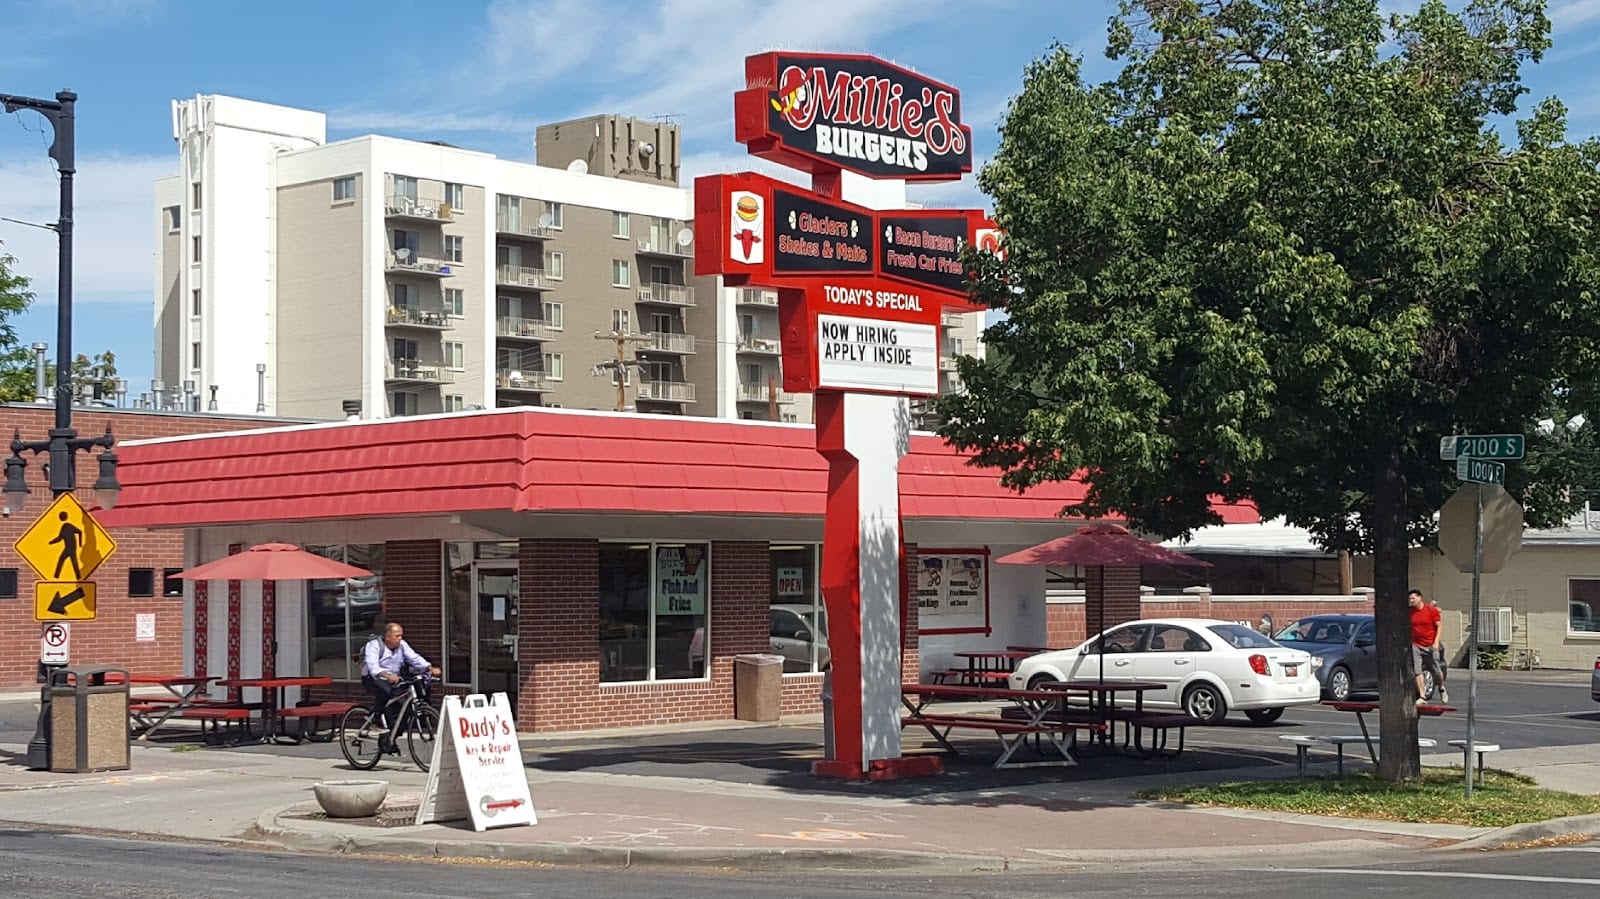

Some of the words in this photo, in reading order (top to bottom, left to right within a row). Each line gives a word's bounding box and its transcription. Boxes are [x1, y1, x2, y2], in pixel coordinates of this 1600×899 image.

[815, 124, 929, 172] BURGERS
[799, 212, 848, 237] Glaciers
[779, 234, 820, 257] Shakes
[822, 240, 834, 259] &
[836, 242, 867, 263] Malts
[895, 226, 921, 247] Bacon
[922, 230, 955, 252] Burgers
[887, 249, 917, 268] Fresh
[918, 253, 937, 271] Cut
[937, 257, 963, 275] Fries
[824, 285, 874, 307] TODAY'S
[875, 291, 923, 312] SPECIAL
[822, 321, 849, 341] NOW
[856, 325, 898, 345] HIRING
[824, 342, 866, 361] APPLY
[874, 345, 912, 366] INSIDE
[1462, 438, 1499, 456] 2100
[1505, 438, 1517, 455] S
[1471, 460, 1494, 482] 1000
[662, 578, 681, 594] Fish
[682, 578, 698, 594] And
[779, 578, 802, 592] OPEN
[668, 595, 692, 611] Fries
[459, 714, 510, 740] Rudy's
[488, 742, 512, 754] Repair
[478, 754, 506, 767] Service
